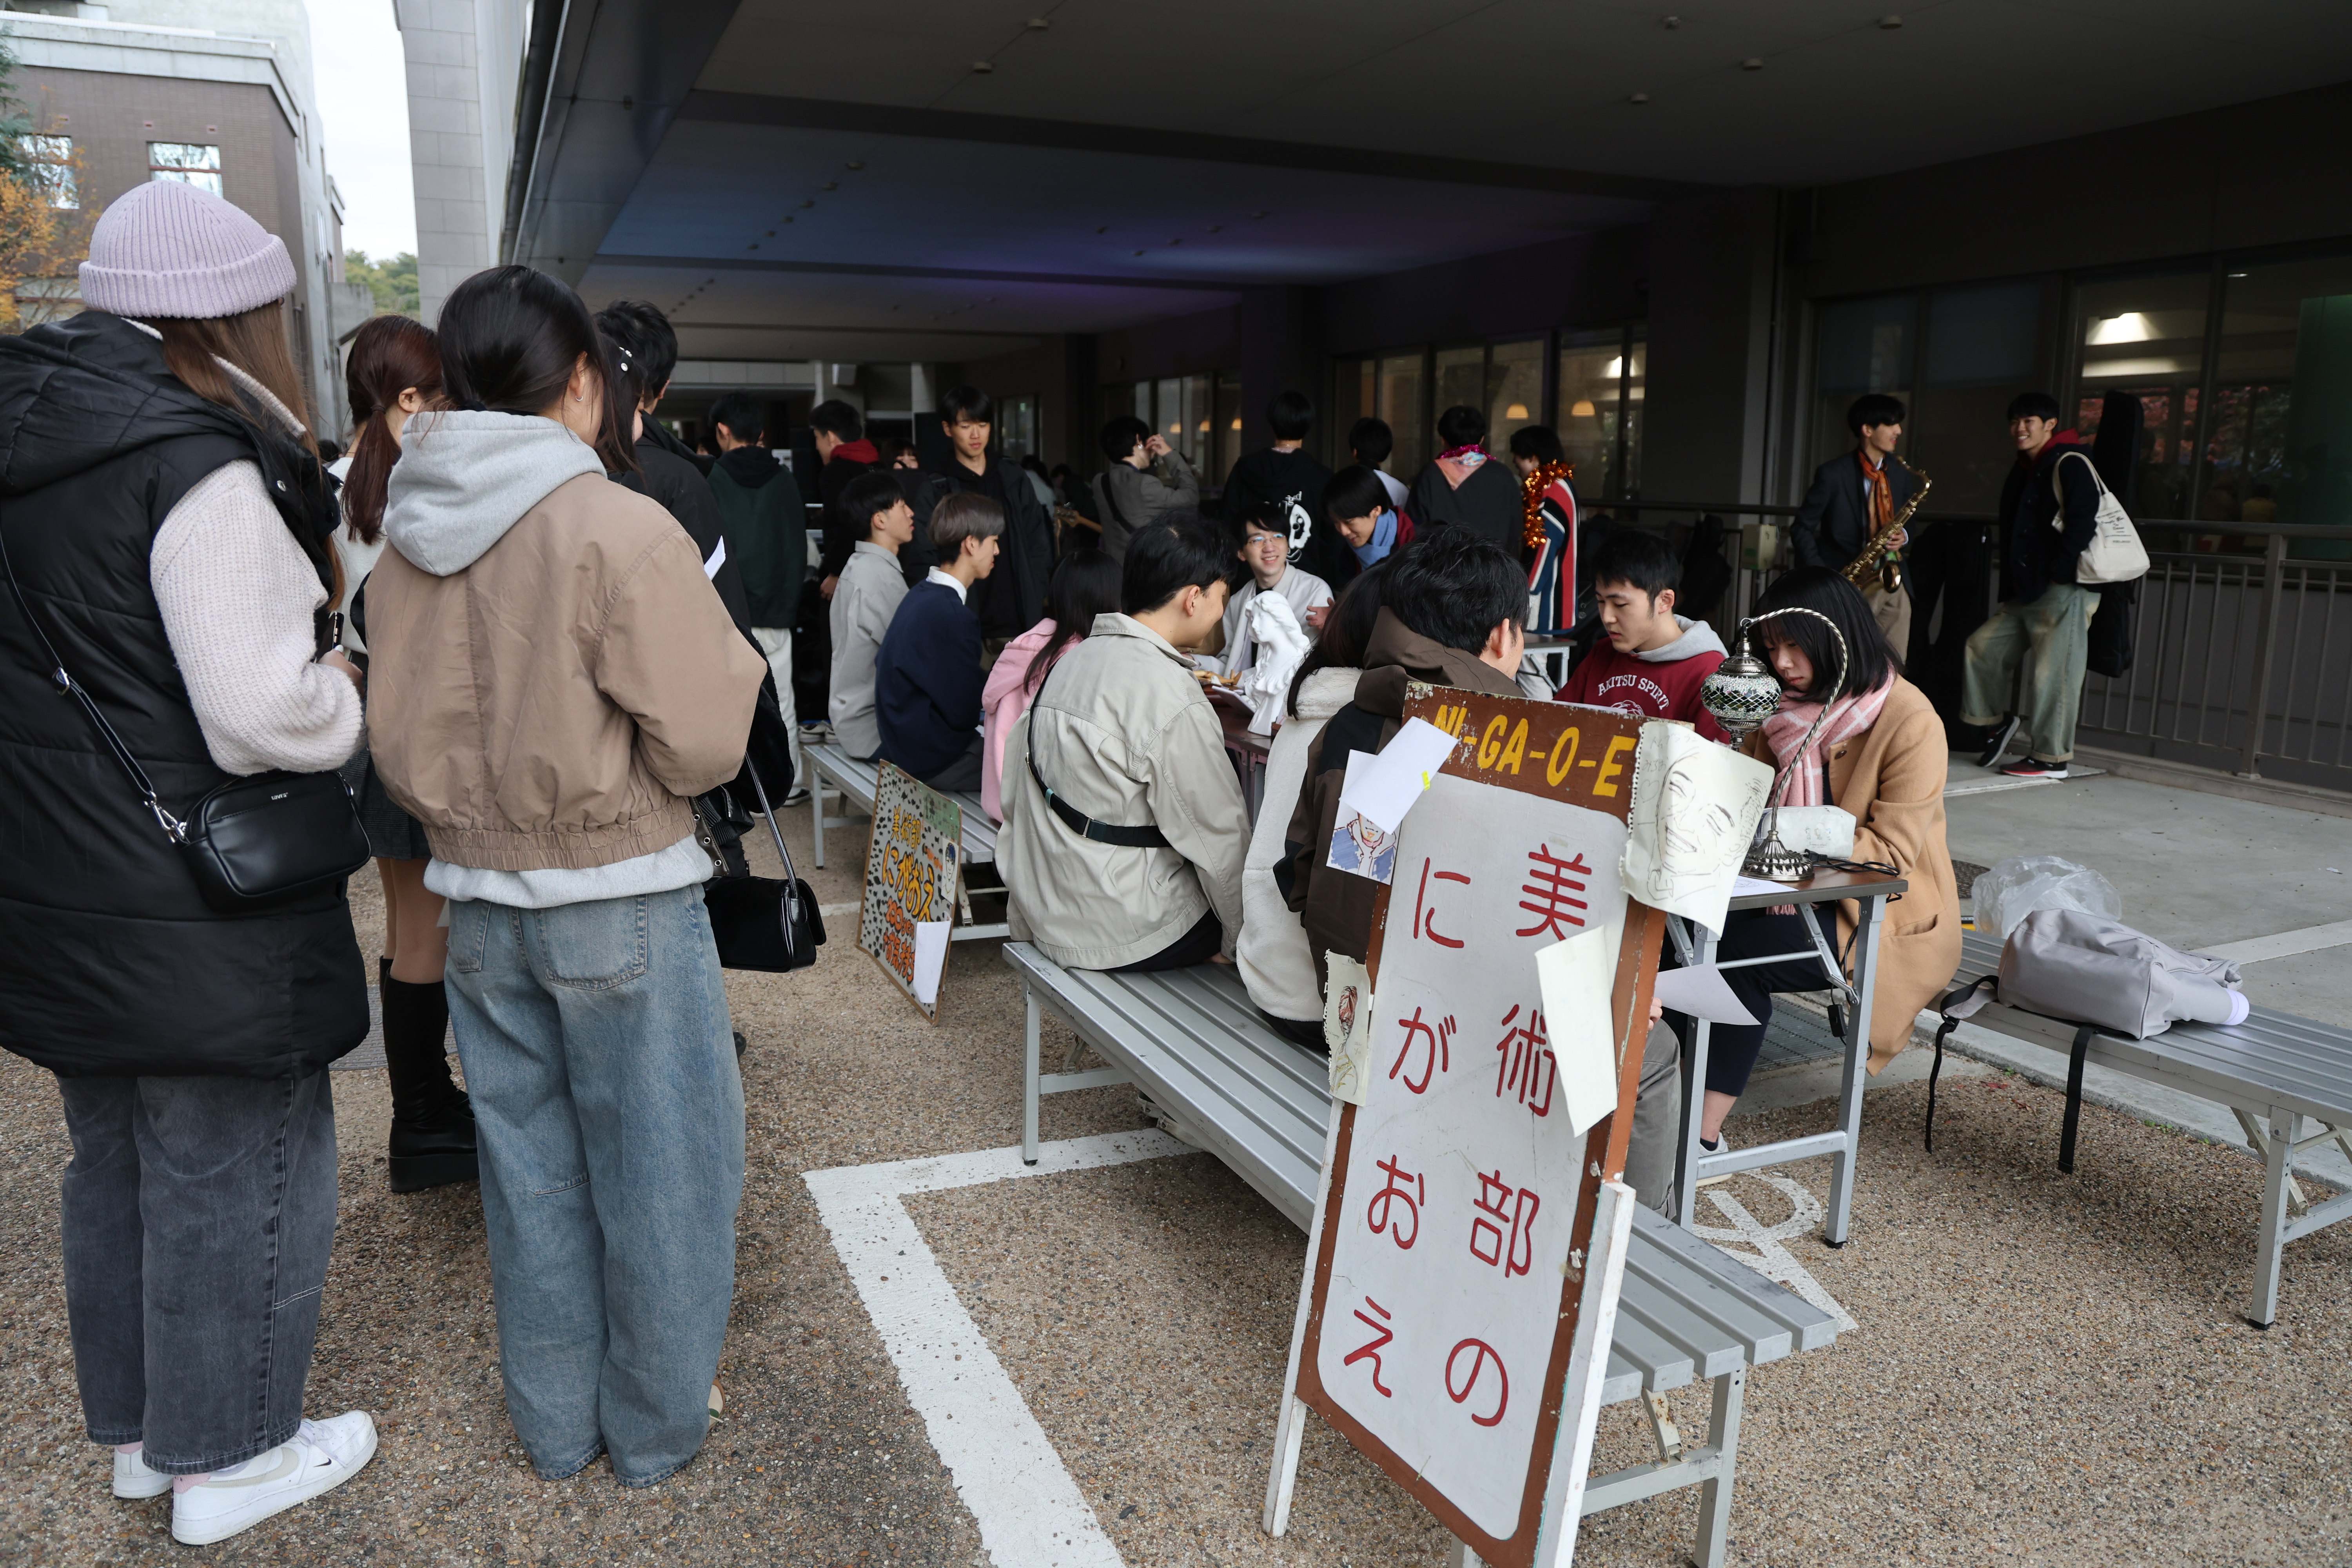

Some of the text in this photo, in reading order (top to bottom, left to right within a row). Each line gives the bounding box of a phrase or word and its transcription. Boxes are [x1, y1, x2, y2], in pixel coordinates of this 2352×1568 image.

[1598, 674, 1670, 711] AKITSU SPIRIT
[891, 803, 920, 854] 美術部
[882, 840, 935, 922] にがおえ
[1344, 857, 1471, 1399] にがおえ
[1444, 843, 1592, 1427] 美術部の
